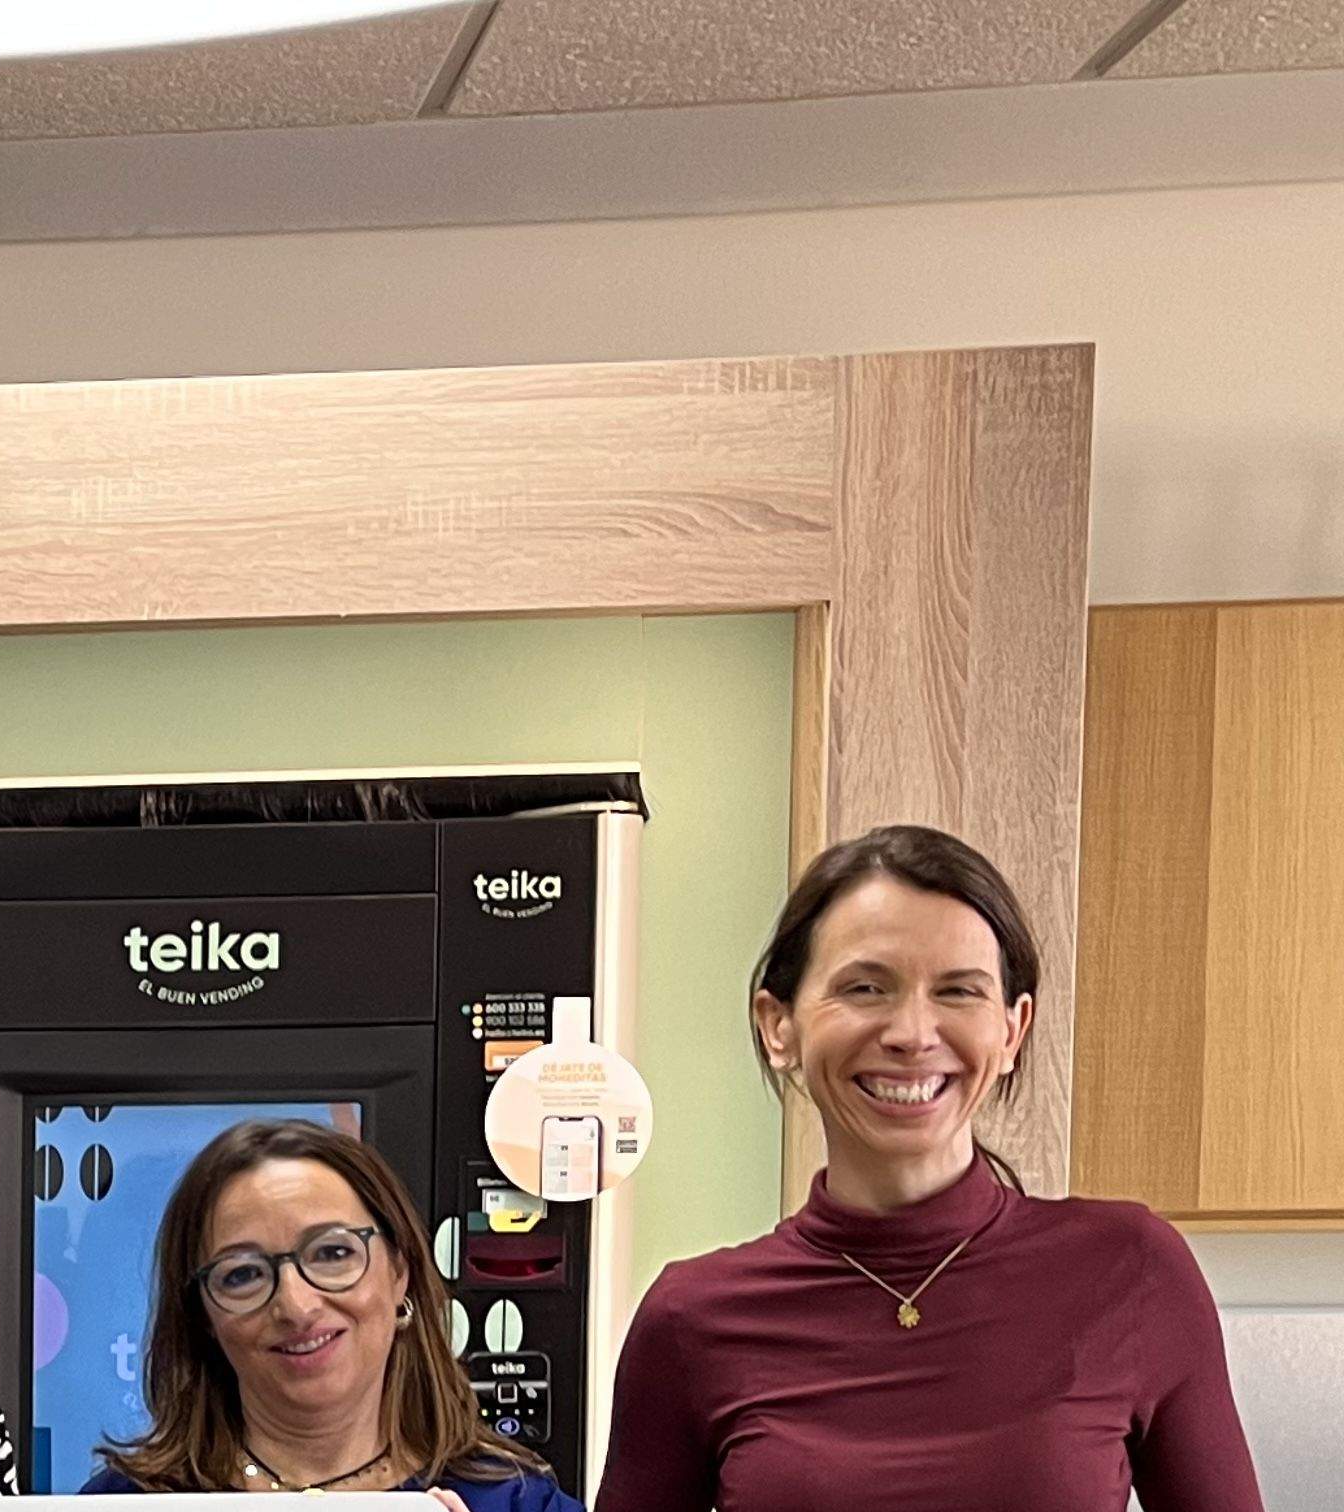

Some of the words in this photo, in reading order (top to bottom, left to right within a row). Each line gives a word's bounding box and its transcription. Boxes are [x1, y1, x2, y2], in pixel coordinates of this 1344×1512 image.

[473, 870, 561, 900] teika
[123, 919, 280, 973] teika
[138, 978, 154, 996] EL
[157, 986, 197, 1006] BUEN
[199, 976, 265, 1006] VENDING
